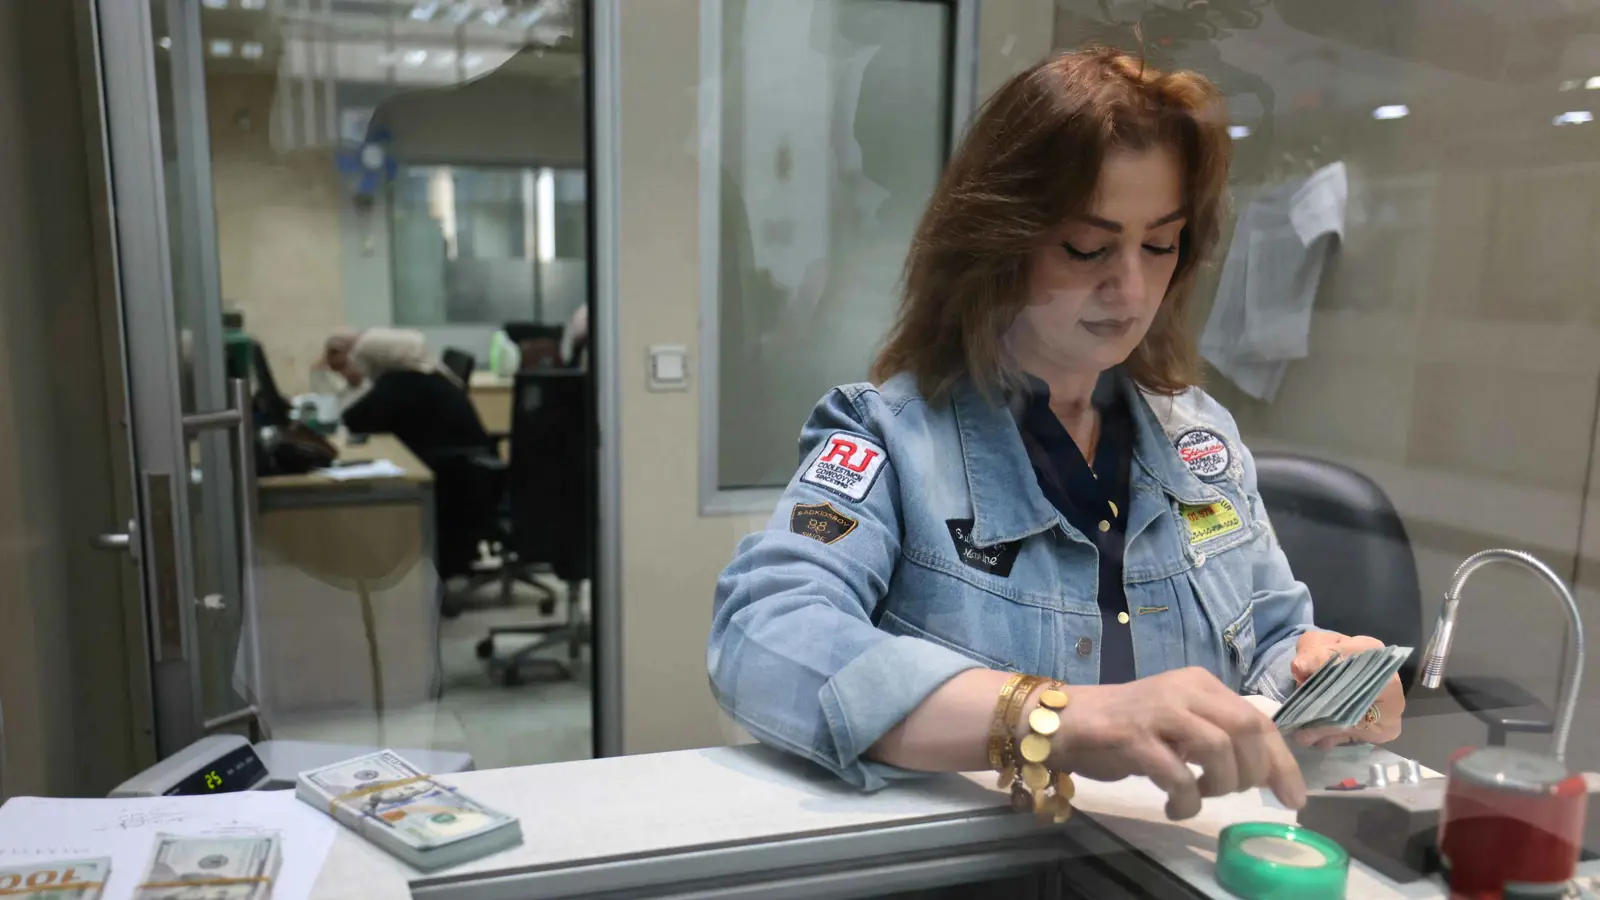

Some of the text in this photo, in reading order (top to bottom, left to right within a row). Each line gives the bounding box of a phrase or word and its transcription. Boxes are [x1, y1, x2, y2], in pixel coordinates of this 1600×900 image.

[820, 438, 879, 473] RJ
[807, 518, 828, 532] 98
[204, 769, 223, 789] 25
